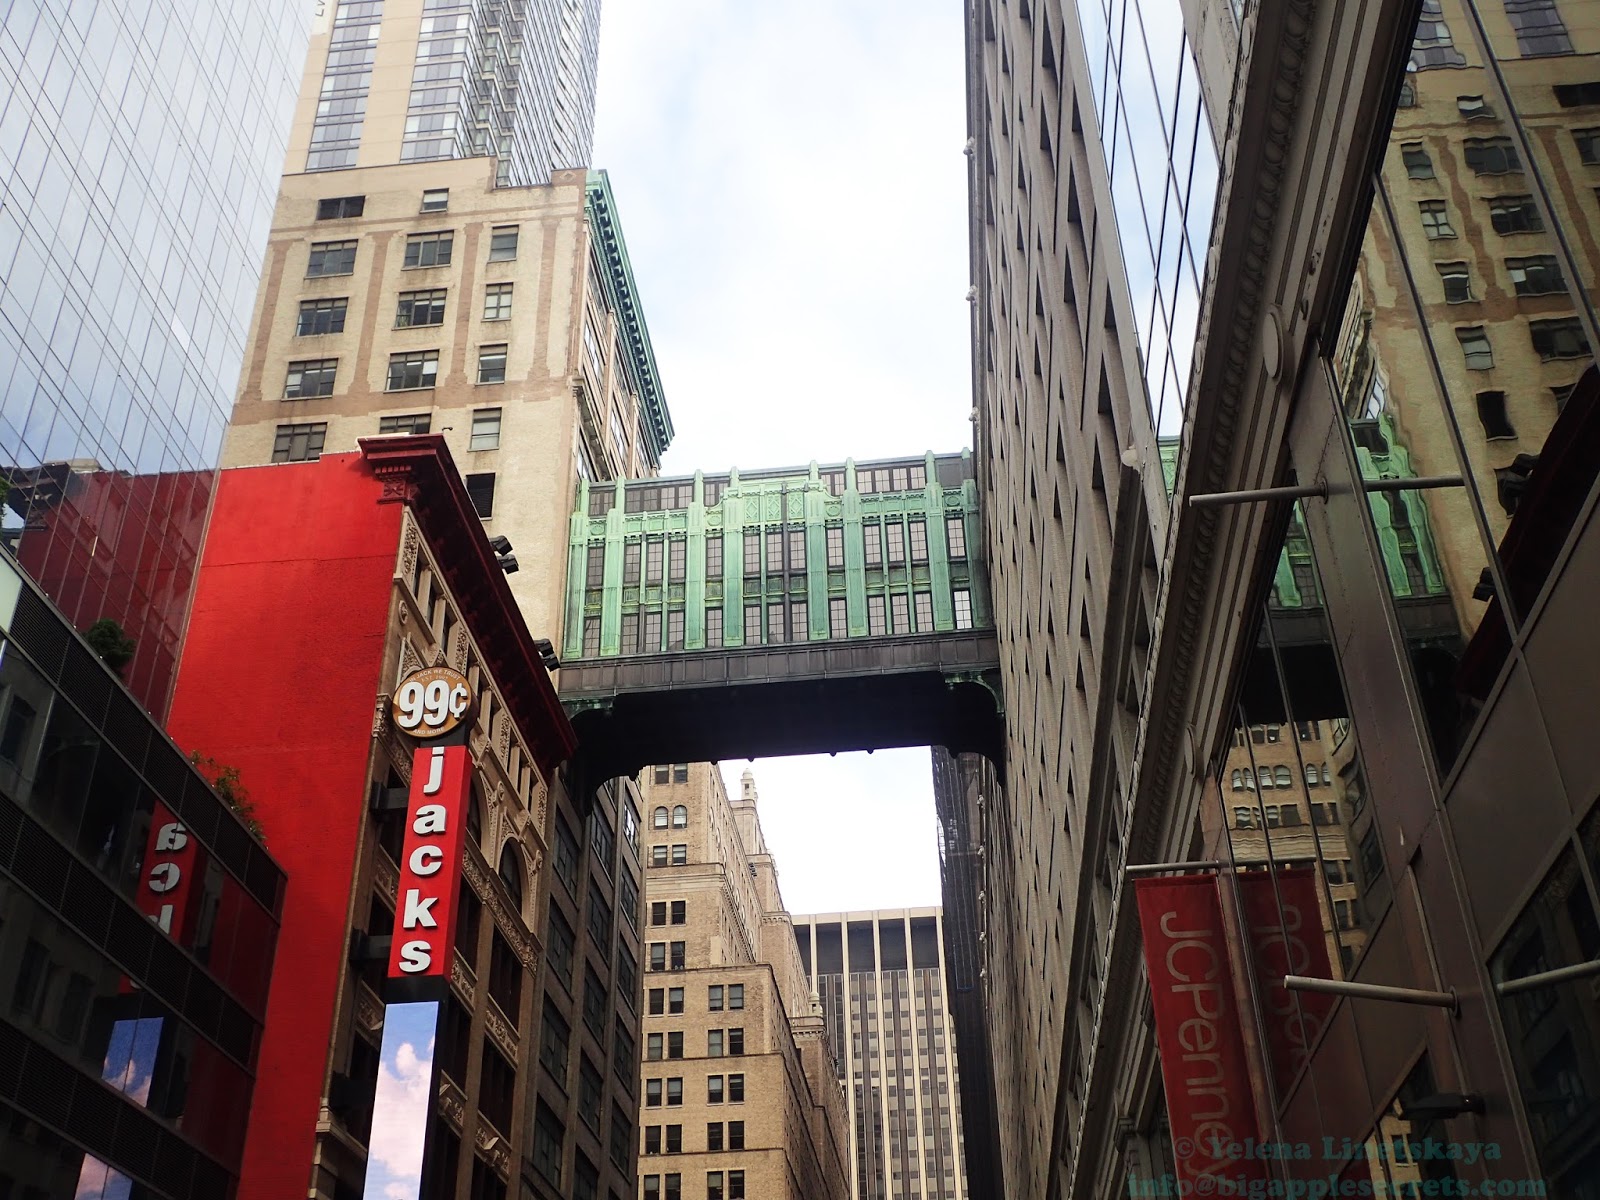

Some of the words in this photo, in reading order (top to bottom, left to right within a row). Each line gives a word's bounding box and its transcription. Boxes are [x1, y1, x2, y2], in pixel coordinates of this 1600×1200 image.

[417, 669, 432, 679] JACK
[443, 669, 461, 681] TRUST
[398, 680, 468, 728] 99¢
[426, 727, 445, 735] MORE
[398, 746, 447, 973] jacks
[1160, 911, 1236, 1177] JCPenney
